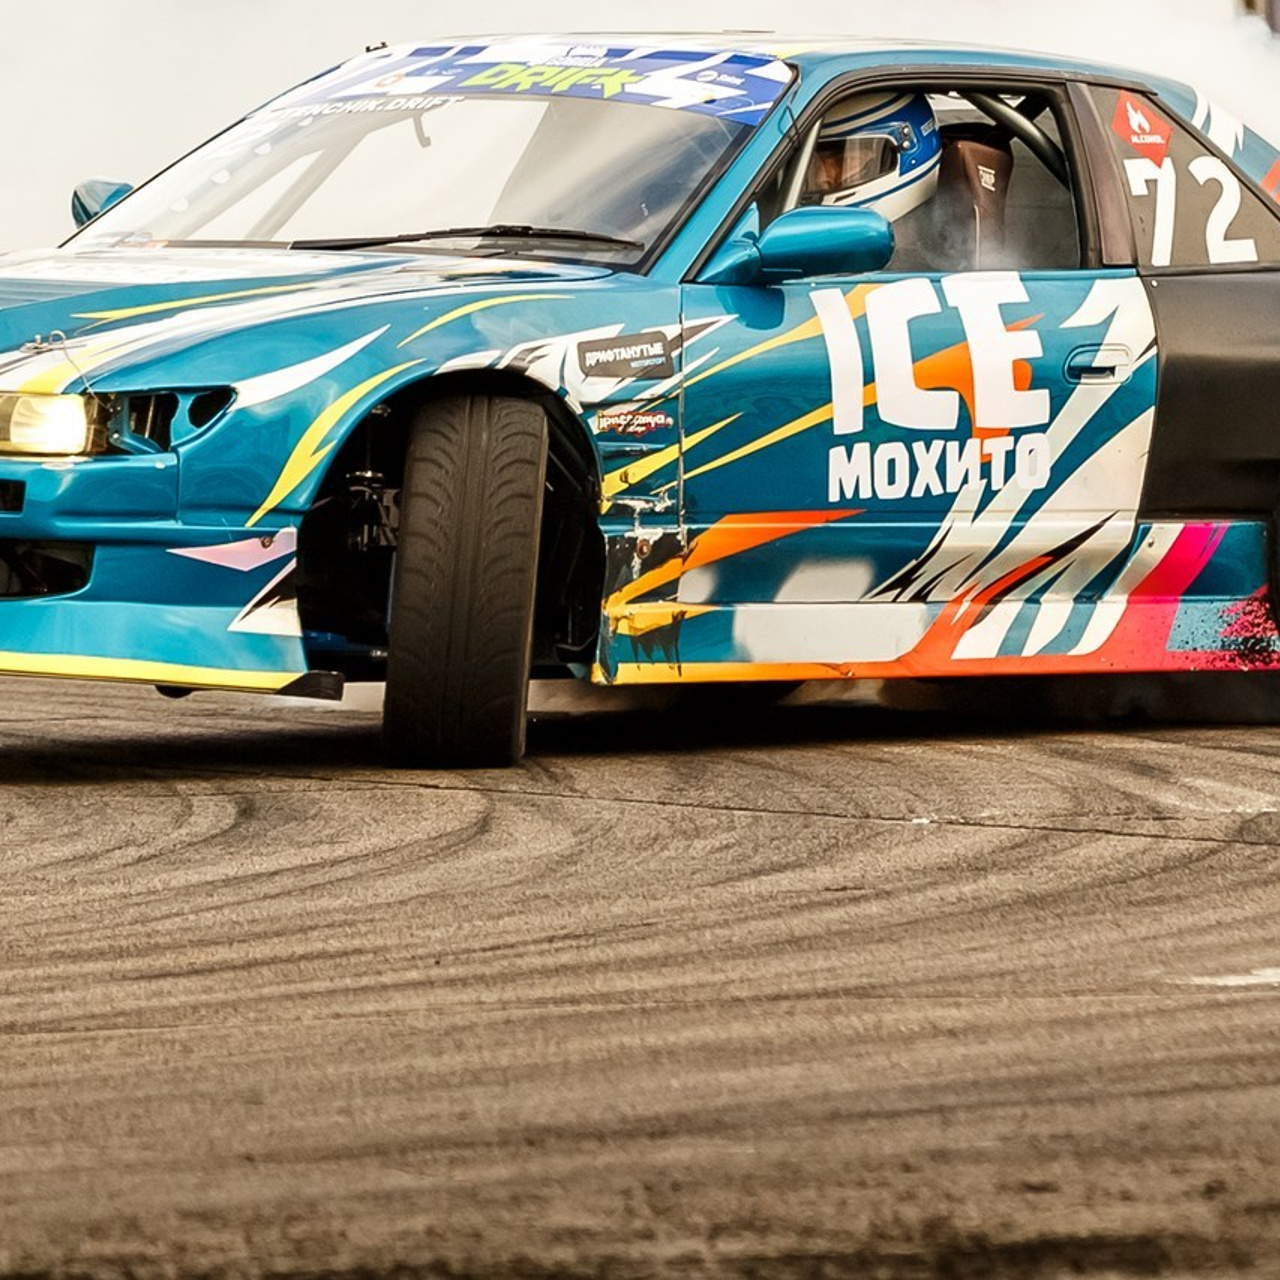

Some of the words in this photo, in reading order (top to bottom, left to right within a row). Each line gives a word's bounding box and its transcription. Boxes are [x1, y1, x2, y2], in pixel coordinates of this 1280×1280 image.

[1122, 155, 1259, 267] 72
[584, 342, 665, 367] ДРИФТАНУТЫЕ
[810, 271, 1051, 435] ICE
[828, 432, 1051, 503] МОХИТО
